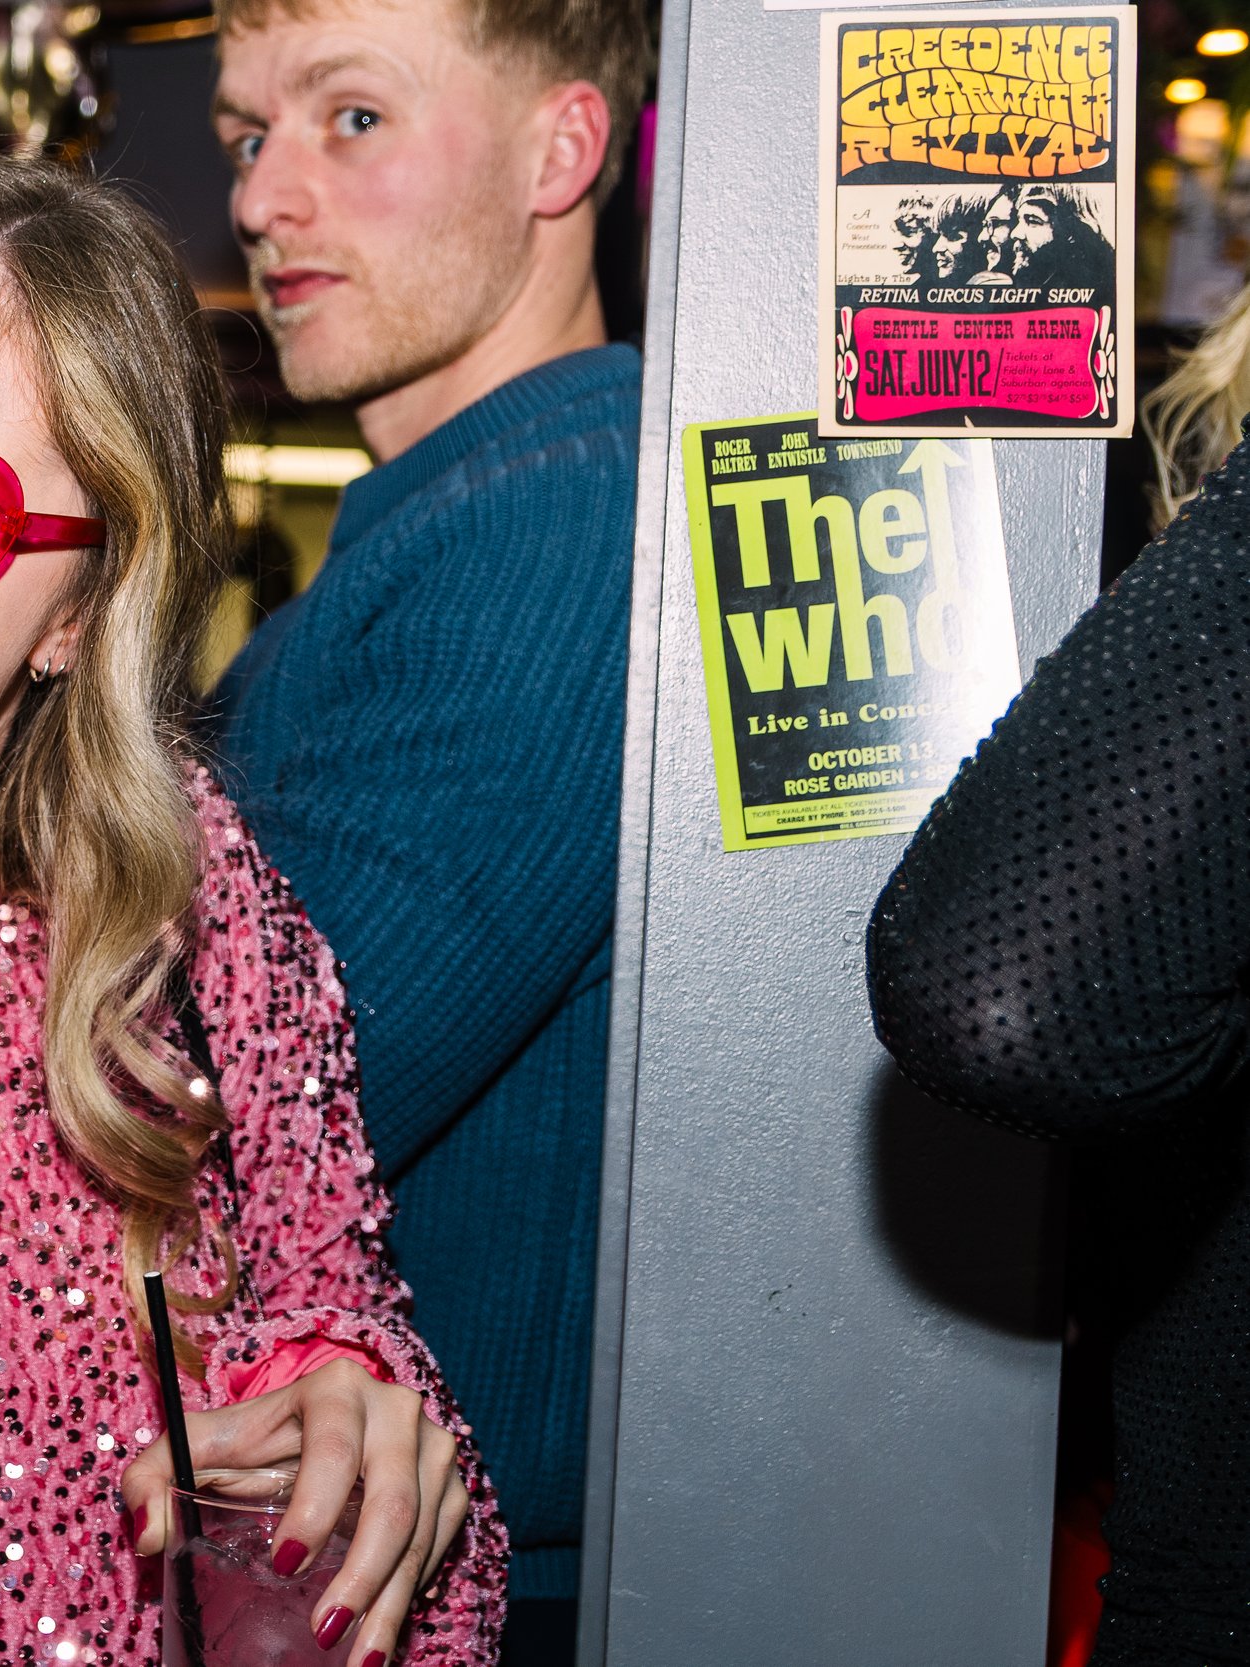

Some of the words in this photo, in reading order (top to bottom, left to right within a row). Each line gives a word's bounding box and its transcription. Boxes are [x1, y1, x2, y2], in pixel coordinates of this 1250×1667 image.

[841, 25, 1112, 99] CREEDENCE
[841, 68, 1112, 142] CLEARWATER
[841, 114, 1110, 177] REVIVAL
[838, 274, 871, 286] Lights
[874, 274, 889, 286] By
[892, 273, 913, 283] The
[859, 288, 920, 304] RETINA
[926, 288, 985, 304] CIRCUS
[989, 288, 1042, 304] LIGHT
[1047, 288, 1095, 304] SHOW
[872, 320, 939, 340] SEATTLE
[953, 320, 1014, 340] CENTER
[1026, 320, 1082, 340] ARENA
[1006, 352, 1038, 361] Tickets
[1042, 353, 1054, 361] at
[1003, 365, 1039, 376] Fidelity
[1068, 364, 1076, 374] &
[1001, 378, 1047, 388] Suburban
[1050, 379, 1093, 390] agencies
[711, 454, 758, 475] DALTREY
[767, 447, 827, 470] ENTWISTLE
[836, 439, 902, 462] TOWNSHEND
[714, 438, 751, 458] ROGER
[781, 432, 809, 450] JOHN
[711, 474, 928, 589] The
[747, 713, 809, 736] Live
[819, 707, 849, 728] in
[808, 744, 903, 772] OCTOBER
[784, 778, 830, 797] ROSE
[833, 768, 905, 791] GARDEN
[752, 810, 781, 819] TICKETS
[781, 806, 819, 815] AVAILABLE
[776, 815, 806, 825] CHARGE
[808, 814, 818, 822] BY
[820, 811, 848, 820] PHONE:
